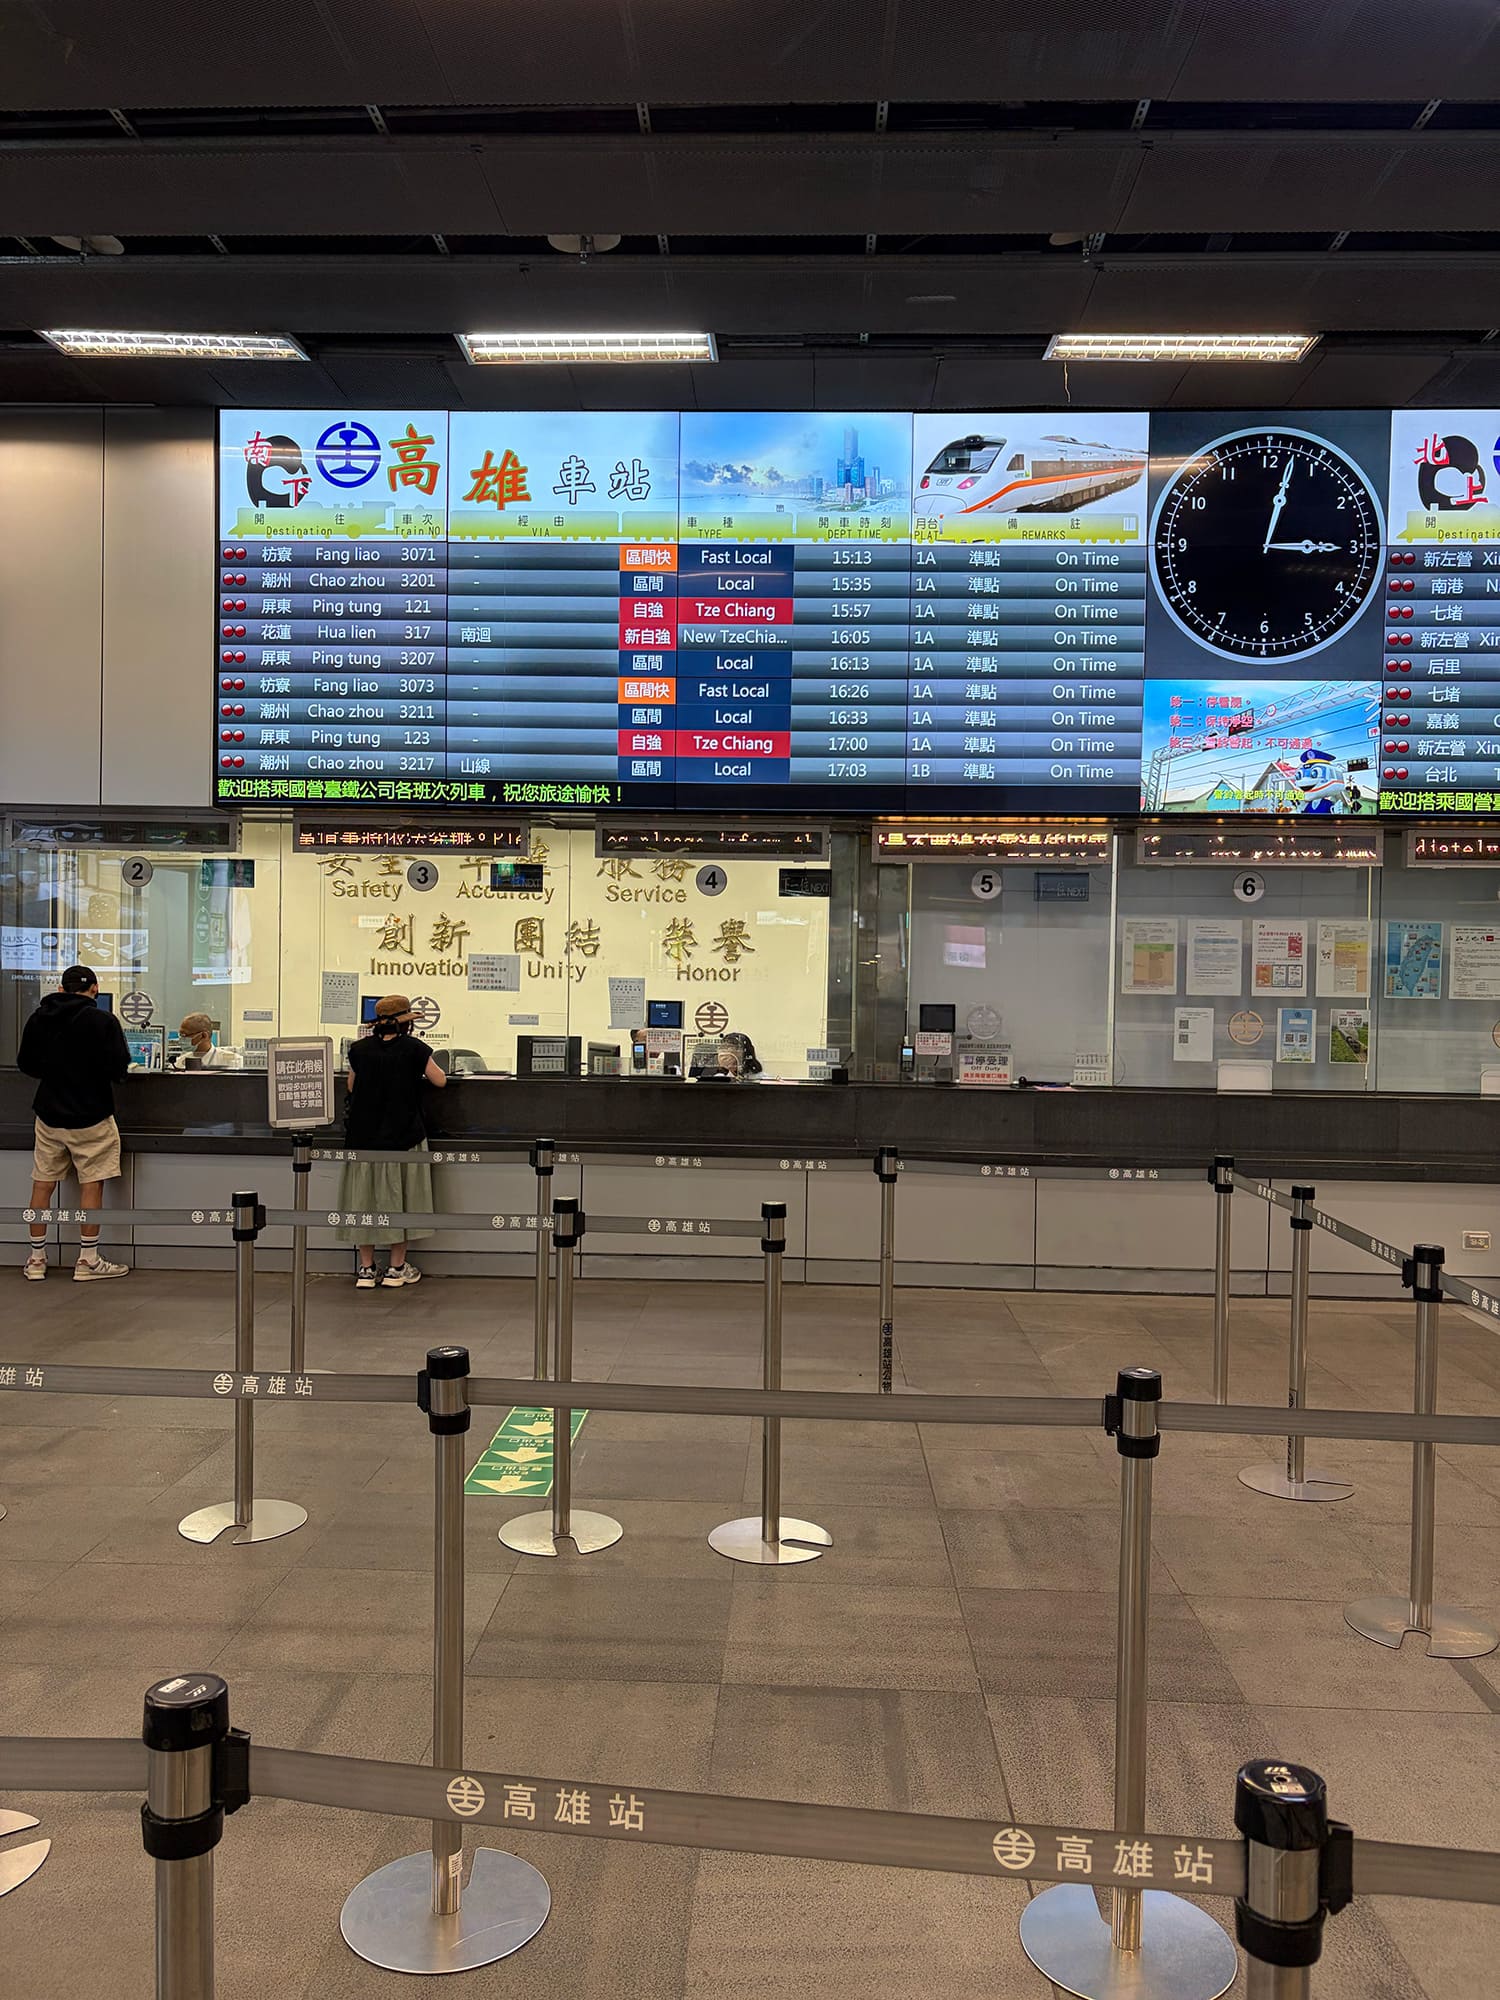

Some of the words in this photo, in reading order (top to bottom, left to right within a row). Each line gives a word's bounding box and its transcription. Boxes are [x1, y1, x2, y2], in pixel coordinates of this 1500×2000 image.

[244, 431, 312, 506] 南下
[386, 422, 651, 511] 高雄車站
[1262, 455, 1278, 468] 12
[1414, 433, 1488, 505] 北上
[1222, 467, 1235, 480] 11
[1191, 496, 1206, 510] 10
[1336, 496, 1345, 509] 2
[402, 513, 433, 526] 車次
[916, 517, 938, 530] 月台
[266, 525, 333, 536] Destination
[394, 526, 424, 536] Train
[531, 528, 550, 537] VIA
[698, 529, 722, 539] TYPE
[827, 529, 852, 539] DEPT
[858, 529, 881, 539] TIME
[914, 531, 938, 540] PLAT
[1022, 530, 1066, 540] REMARKS
[1178, 538, 1187, 552] 9
[1349, 540, 1358, 554] 3
[261, 547, 293, 563] 枋寮
[316, 548, 350, 564] Fang
[354, 547, 380, 561] liao
[401, 548, 435, 561] 3071
[626, 549, 671, 565] 區間快
[701, 550, 731, 564] Fast
[734, 550, 772, 564] Local
[832, 551, 872, 565] 15:13
[916, 552, 936, 565] 1A
[969, 550, 1000, 567] 準點
[1056, 552, 1077, 565] On
[1082, 552, 1119, 565] Time
[1423, 551, 1472, 567] 新左營
[261, 572, 292, 588] 潮州
[309, 573, 345, 587] Chao
[350, 573, 385, 587] zhou
[401, 574, 435, 587] 3201
[633, 576, 664, 592] 區間
[717, 576, 754, 591] Local
[832, 577, 871, 591] 15:35
[915, 578, 935, 592] 1A
[968, 577, 1000, 594] 準點
[1055, 579, 1077, 592] On
[1082, 578, 1118, 592] Time
[1187, 580, 1197, 593] 8
[1335, 581, 1344, 594] 4
[1431, 578, 1464, 594] 南港
[261, 598, 292, 614] 屏東
[313, 600, 343, 616] Ping
[348, 600, 382, 616] tung
[405, 600, 431, 614] 121
[633, 602, 663, 618] 自強
[695, 603, 721, 617] Tze
[724, 602, 775, 620] Chiang
[831, 604, 871, 618] 15:57
[1430, 604, 1463, 622] 七堵
[1217, 612, 1226, 625] 7
[1304, 613, 1313, 626] 5
[261, 624, 292, 640] 花蓮
[318, 626, 346, 639] Hua
[351, 625, 376, 639] lien
[404, 626, 431, 639] 317
[1259, 621, 1269, 633] 6
[461, 627, 491, 643] 南迴
[624, 628, 671, 645] 新自強
[683, 630, 716, 644] New
[720, 629, 788, 644] TzeChia...
[831, 630, 870, 644] 16:05
[1420, 632, 1470, 648] 新左營
[260, 651, 291, 666] 屏東
[312, 651, 343, 667] Ping
[348, 652, 381, 667] tung
[400, 652, 435, 665] 3207
[632, 655, 662, 671] 區間
[716, 656, 753, 670] Local
[830, 656, 869, 671] 16:13
[1427, 659, 1461, 675] 后里
[260, 677, 291, 693] 枋寮
[314, 679, 348, 695] Fang
[353, 678, 378, 692] liao
[399, 679, 435, 693] 3073
[624, 682, 670, 698] 區間快
[699, 683, 728, 698] Fast
[732, 683, 769, 698] Local
[829, 684, 869, 698] 16:26
[1428, 686, 1461, 703] 七堵
[260, 703, 290, 719] 潮州
[307, 704, 345, 718] Chao
[349, 704, 384, 718] zhou
[399, 705, 434, 719] 3211
[632, 709, 662, 725] 區間
[715, 709, 752, 724] Local
[829, 711, 868, 724] 16:33
[1426, 713, 1460, 730] 嘉義
[259, 729, 290, 745] 屏東
[311, 730, 342, 746] Ping
[347, 731, 381, 747] tung
[404, 731, 430, 745] 123
[632, 735, 662, 751] 自強
[693, 736, 718, 750] Tze
[722, 735, 773, 754] Chiang
[828, 737, 868, 751] 17:00
[911, 738, 931, 751] 1A
[964, 736, 995, 753] 準點
[1051, 738, 1073, 751] On
[1078, 738, 1114, 752] Time
[1417, 740, 1466, 756] 新左營
[259, 755, 289, 771] 潮州
[307, 756, 345, 770] Chao
[348, 756, 384, 770] zhou
[399, 757, 434, 771] 3217
[461, 758, 491, 775] 山線
[631, 761, 662, 777] 區間
[714, 761, 751, 776] Local
[828, 763, 867, 777] 17:03
[911, 764, 930, 777] 1B
[963, 763, 995, 780] 準點
[1050, 764, 1072, 778] On
[1077, 764, 1113, 778] Time
[1425, 766, 1457, 783] 台北
[217, 779, 622, 803] 歡迎搭乘國營臺鐵公司各班次列車，祝您旅途愉快！
[131, 863, 143, 879] 2
[416, 866, 429, 884] 3
[705, 871, 718, 888] 4
[980, 875, 993, 892] 5
[1242, 877, 1255, 896] 6
[332, 879, 403, 902] Safety
[605, 884, 688, 903] Service
[375, 912, 471, 958] 創新
[514, 915, 601, 958] 團結
[661, 917, 756, 964] 榮譽
[370, 957, 468, 977] Innovatio
[527, 960, 587, 983] Unity
[677, 964, 741, 982] Honor
[323, 1150, 357, 1161] 高雄站
[446, 1152, 480, 1163] 高雄站
[668, 1156, 702, 1167] 高雄站
[793, 1159, 828, 1170] 高雄站
[994, 1164, 1029, 1177] 高雄站
[1122, 1168, 1159, 1180] 高雄站
[40, 1209, 87, 1223] 高雄站
[345, 1213, 390, 1227] 高雄站
[509, 1215, 555, 1229] 高雄站
[665, 1220, 711, 1234] 高雄站
[241, 1374, 314, 1396] 高雄站
[503, 1783, 646, 1832] 高雄站
[1055, 1834, 1214, 1884] 高雄站
